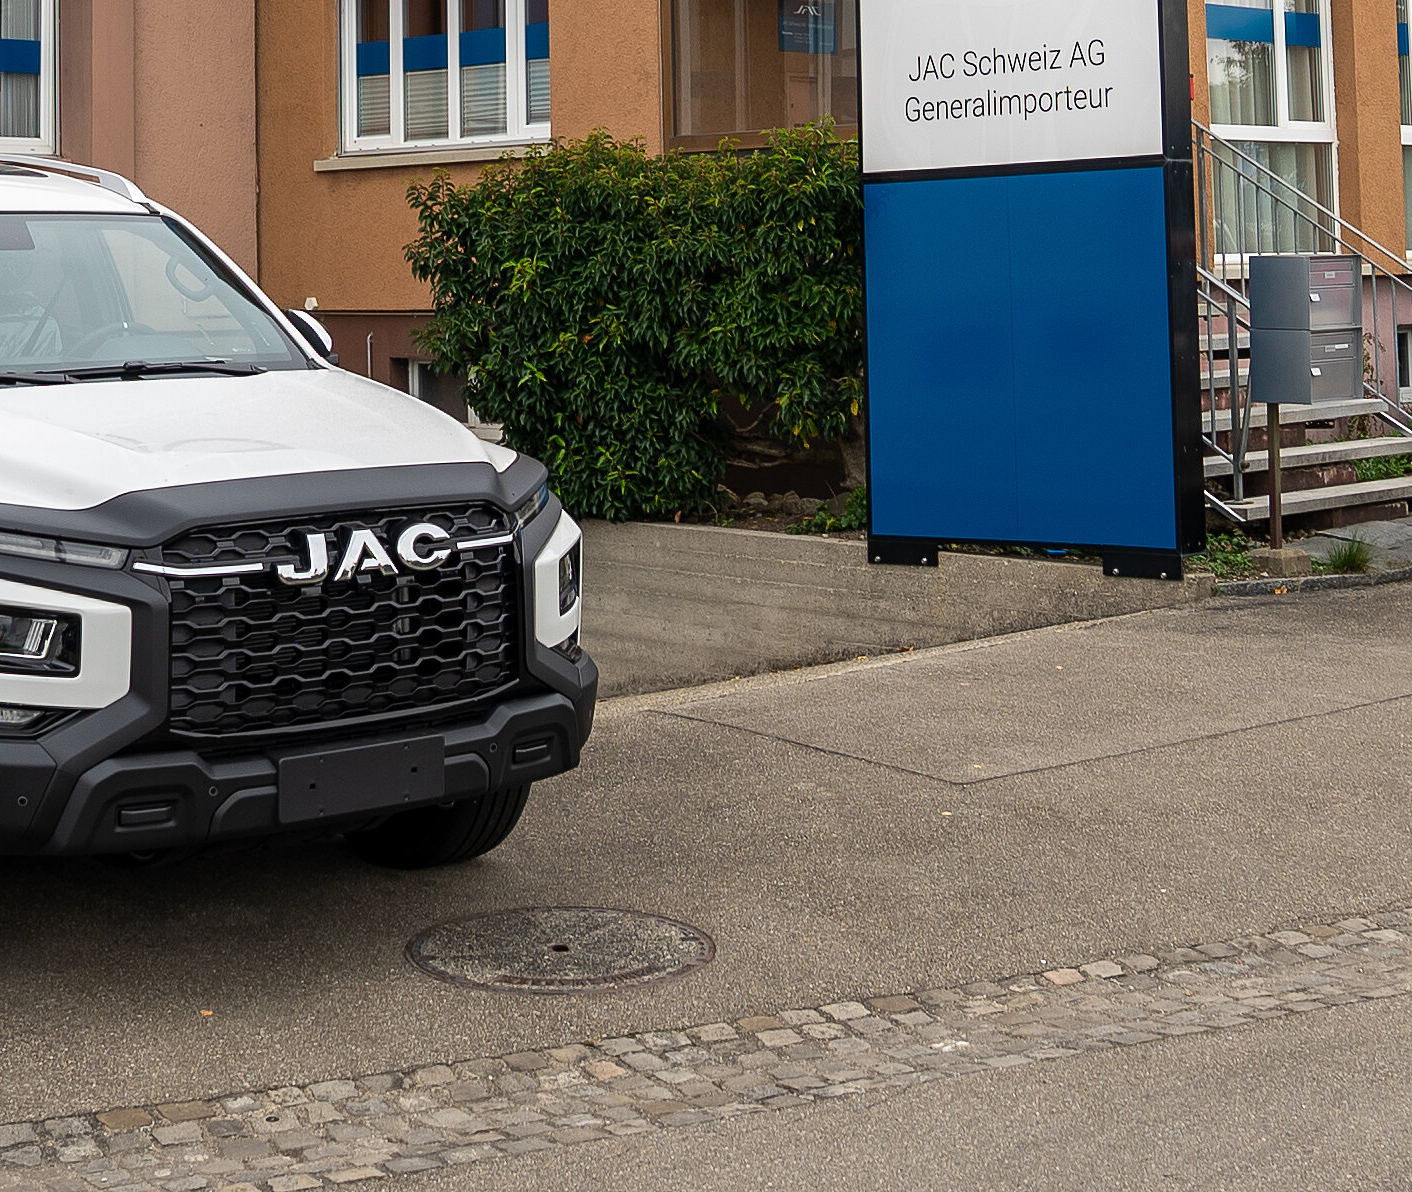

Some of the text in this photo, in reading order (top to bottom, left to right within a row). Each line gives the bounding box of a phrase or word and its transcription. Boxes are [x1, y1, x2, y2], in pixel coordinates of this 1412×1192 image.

[908, 38, 1106, 82] JAC Schweiz AG
[904, 84, 1114, 123] Generalimporteur
[276, 522, 452, 586] JAC
